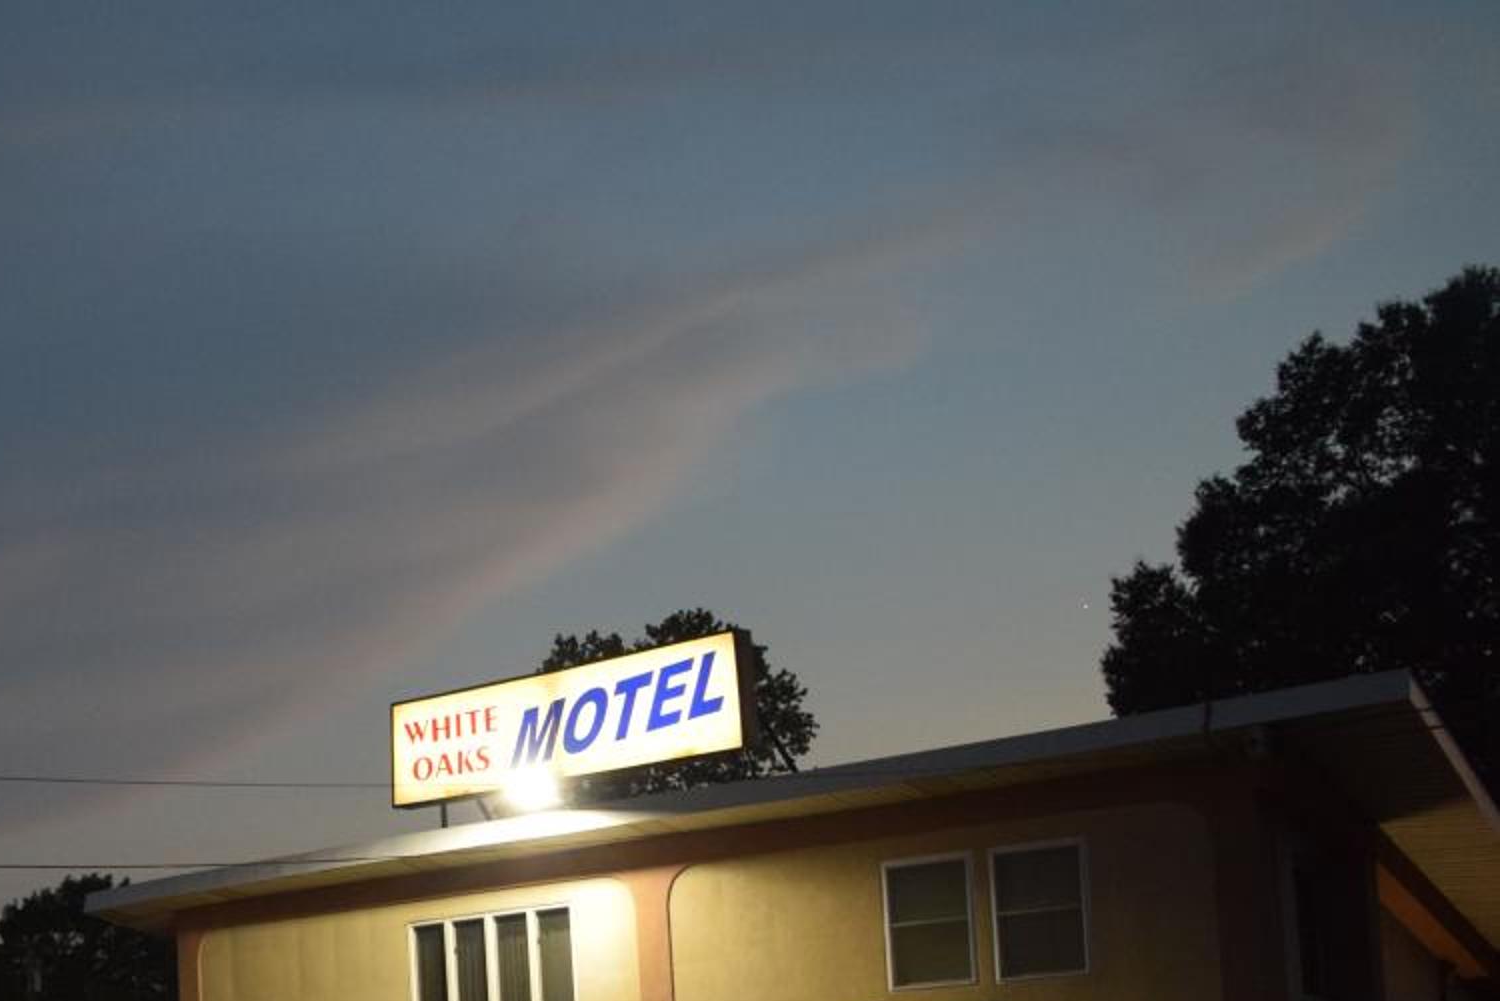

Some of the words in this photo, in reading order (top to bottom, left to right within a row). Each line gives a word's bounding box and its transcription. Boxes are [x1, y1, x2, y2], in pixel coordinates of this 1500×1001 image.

[404, 706, 498, 744] WHITE
[511, 651, 725, 767] MOTEL
[413, 746, 490, 781] OAKS
